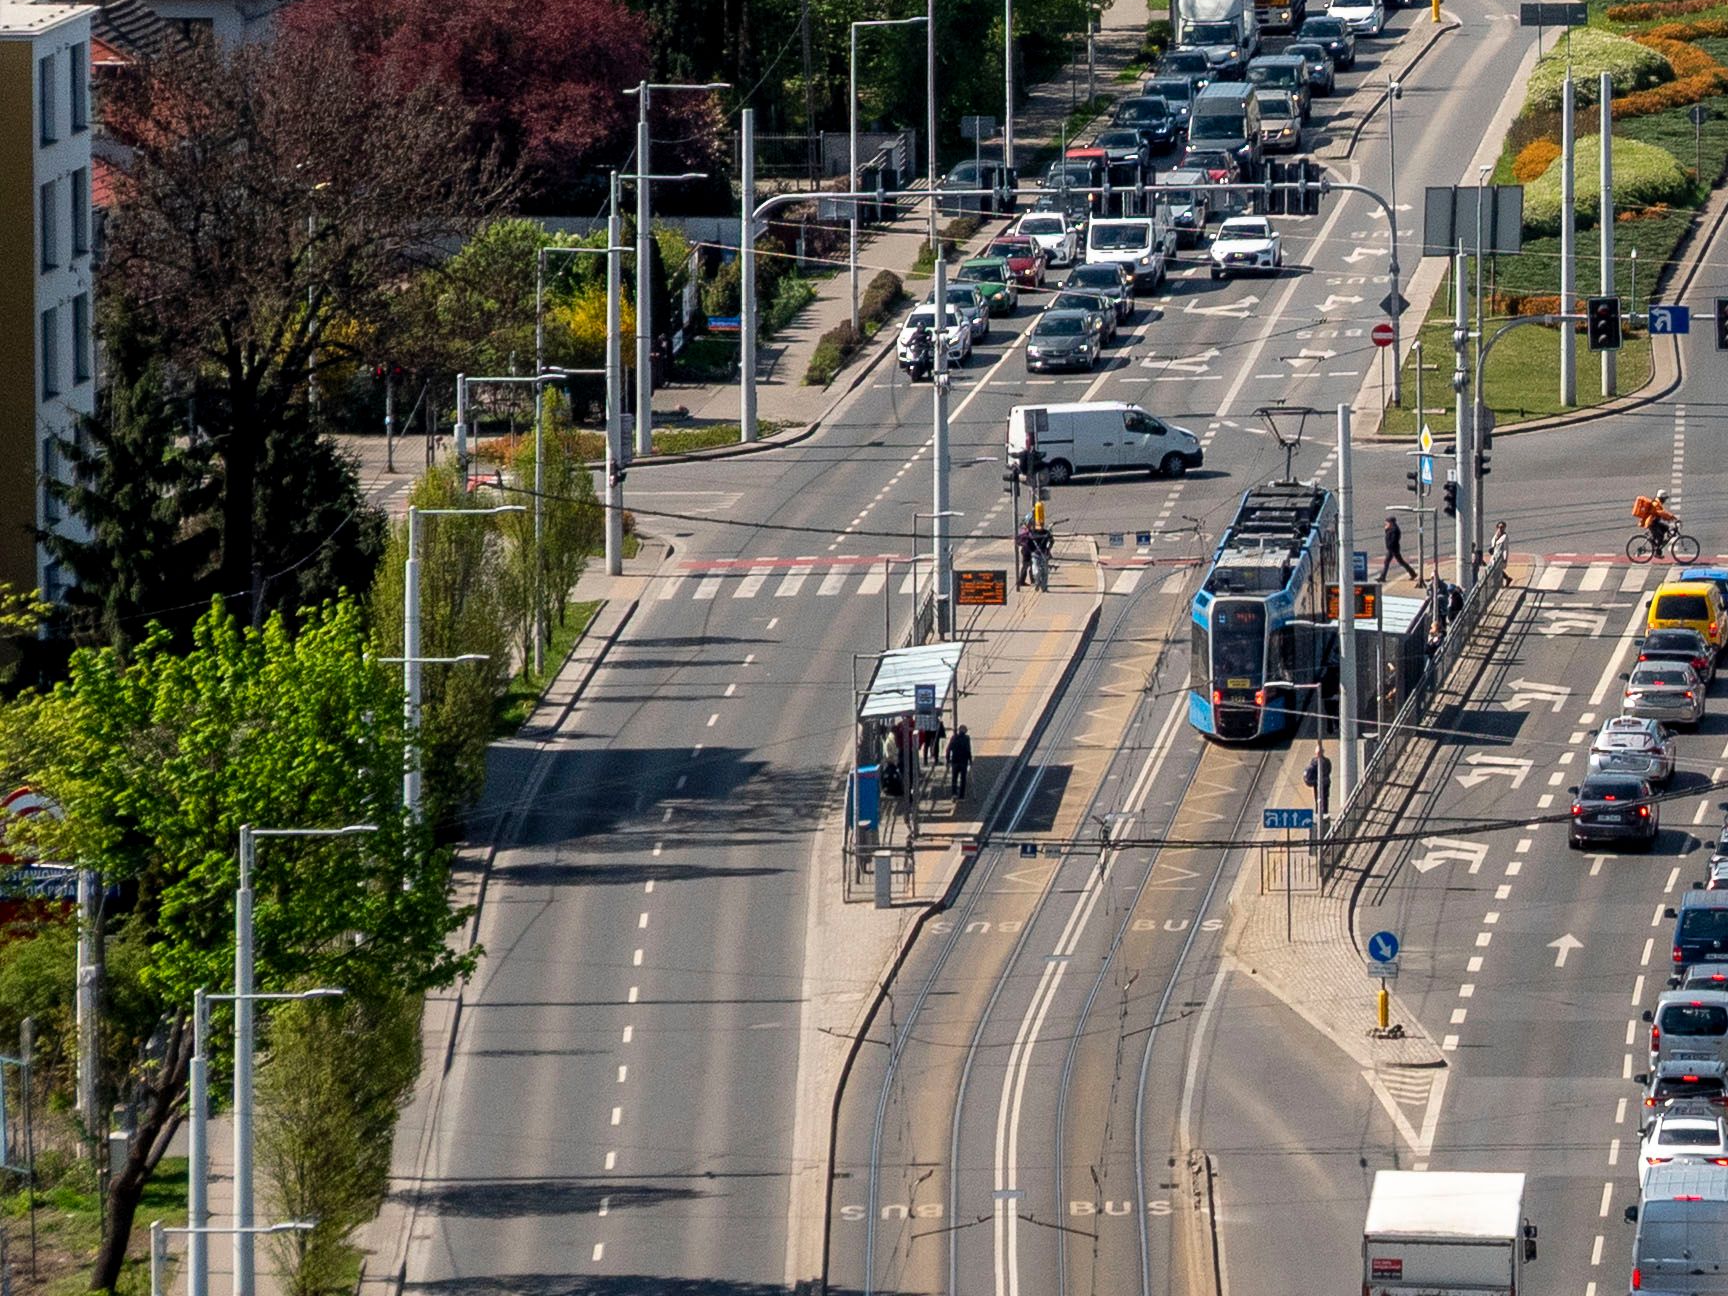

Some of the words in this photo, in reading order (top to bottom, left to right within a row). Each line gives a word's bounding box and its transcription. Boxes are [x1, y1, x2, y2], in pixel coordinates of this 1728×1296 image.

[930, 919, 1024, 935] BUS
[1131, 918, 1224, 933] BUS
[840, 1202, 944, 1221] BUS
[1069, 1200, 1174, 1216] BUS
